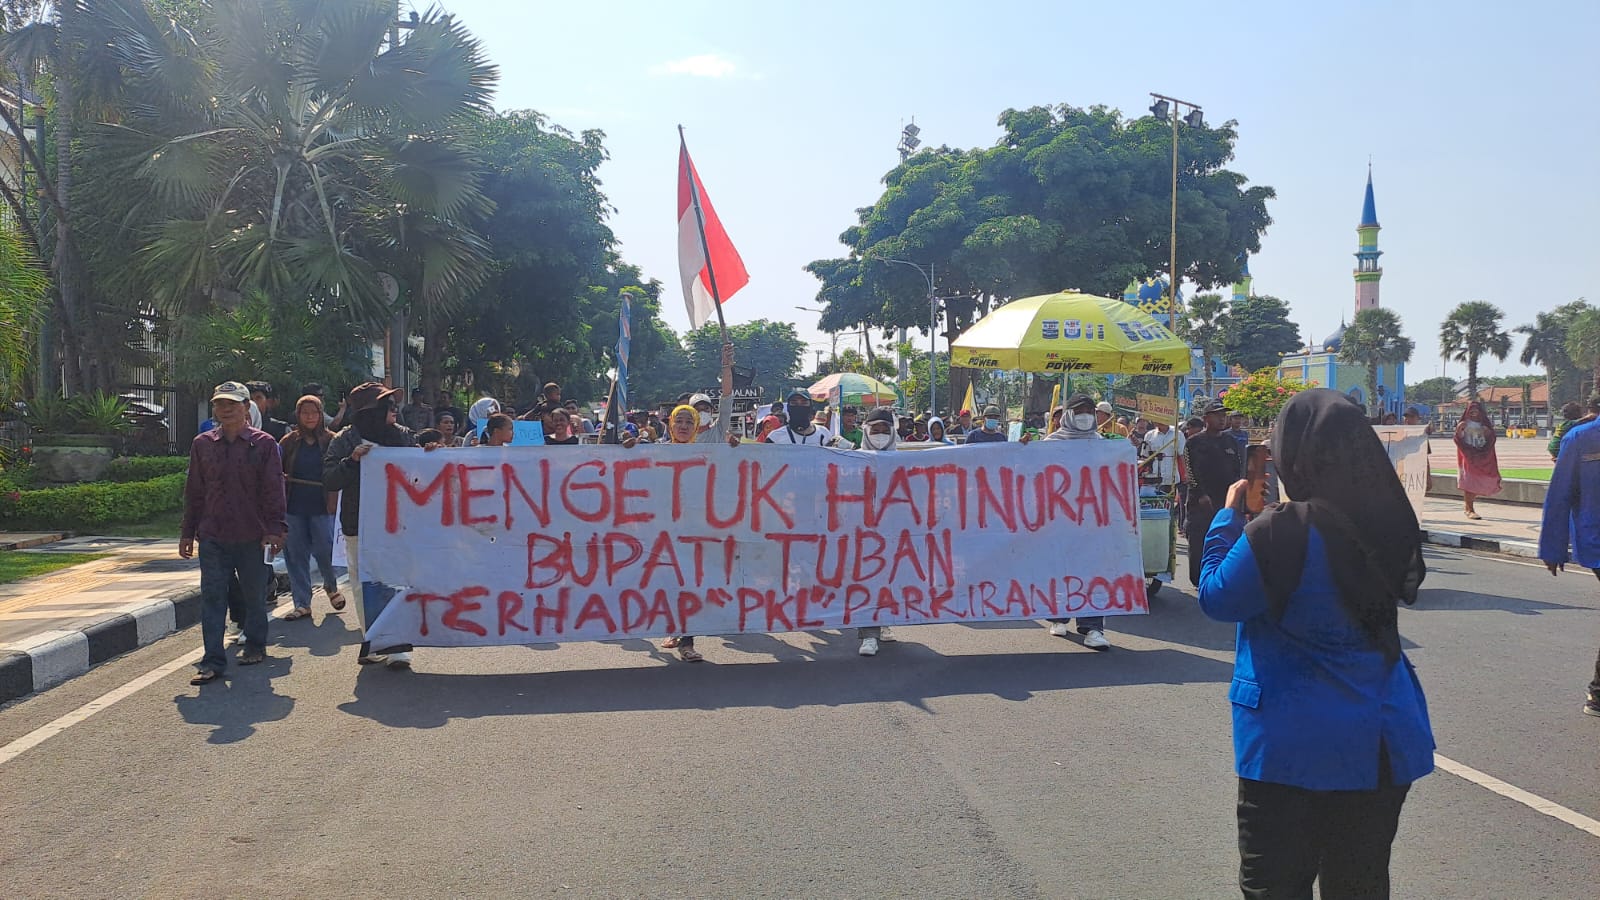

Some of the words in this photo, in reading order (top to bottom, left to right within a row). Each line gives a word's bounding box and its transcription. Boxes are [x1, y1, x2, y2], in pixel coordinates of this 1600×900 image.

[968, 357, 1000, 367] POWER
[1045, 362, 1092, 373] POWER
[1141, 363, 1173, 373] POWER
[385, 460, 793, 534] MENGETUK
[526, 530, 736, 589] BUPATI
[765, 528, 954, 595] TUBAN
[405, 586, 702, 636] TERHADAP
